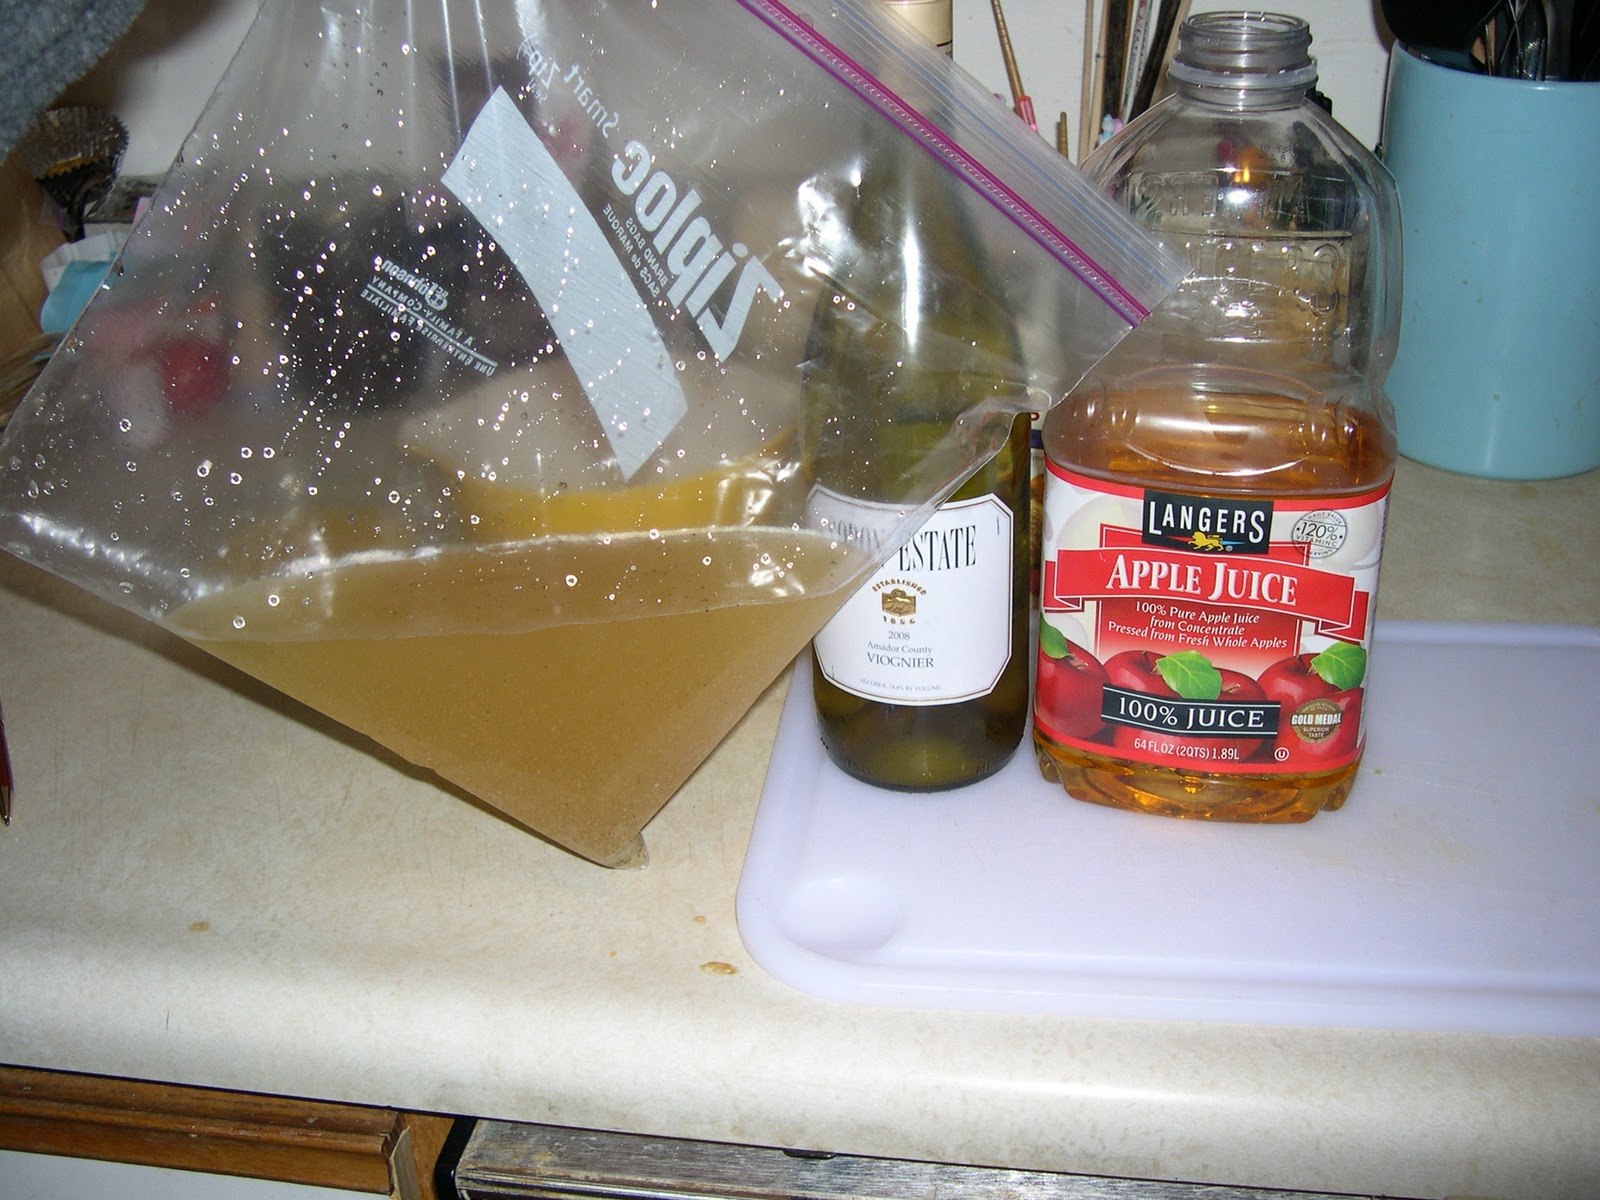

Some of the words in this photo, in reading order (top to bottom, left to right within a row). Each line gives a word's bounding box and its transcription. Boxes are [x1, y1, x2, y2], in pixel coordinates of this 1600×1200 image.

[1148, 500, 1265, 544] LANGERS
[1301, 522, 1339, 541] 120%
[899, 525, 976, 572] ESTATE
[1105, 554, 1202, 596] APPLE
[1208, 562, 1298, 606] JUICE
[1135, 601, 1167, 616] 100%
[1169, 606, 1196, 621] Pure
[1198, 611, 1231, 625] Apple
[1233, 612, 1260, 624] Juice
[888, 630, 911, 641] 2008
[1108, 620, 1148, 638] Pressed
[1150, 628, 1175, 643] from
[1178, 633, 1209, 647] Fresh
[1213, 636, 1248, 648] Whole
[1250, 637, 1288, 650] Apples
[1150, 615, 1175, 630] from
[1178, 620, 1245, 636] Concentrate
[867, 641, 900, 652] Amador
[901, 645, 933, 655] County
[866, 652, 935, 668] VIOGNIER
[1119, 697, 1178, 726] 100%
[1186, 708, 1264, 730] JUICE
[1291, 714, 1314, 725] GOLD
[1315, 712, 1342, 725] MEDAL
[1134, 737, 1147, 750] 64
[1148, 741, 1159, 752] FL
[1160, 743, 1174, 755] OZ
[1176, 746, 1210, 760] (2QTS)
[1211, 747, 1240, 760] 1.89L
